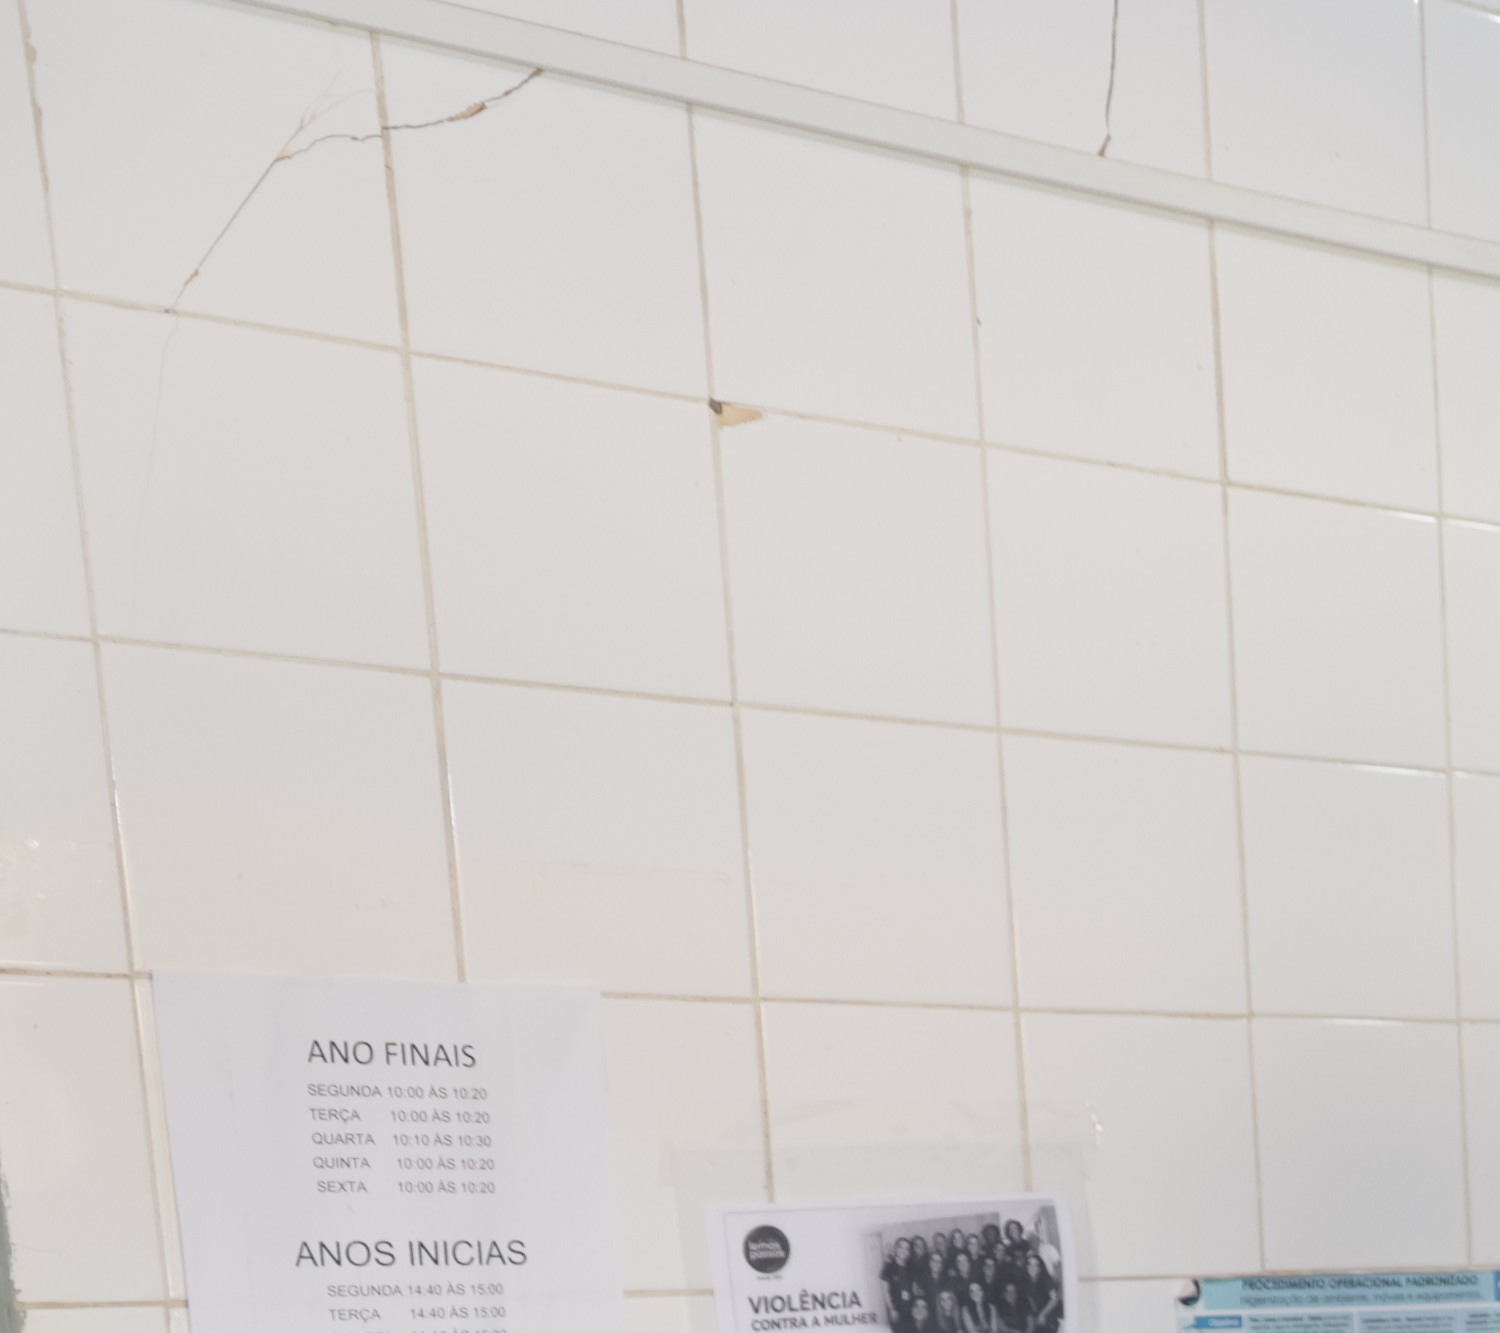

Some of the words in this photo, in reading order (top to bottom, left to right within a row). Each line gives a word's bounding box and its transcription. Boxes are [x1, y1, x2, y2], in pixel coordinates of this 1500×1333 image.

[307, 1040, 374, 1065] ANO
[385, 1042, 477, 1068] FINAIS
[307, 1084, 383, 1098] SEGUNDA
[387, 1086, 424, 1098] 10:00
[428, 1084, 448, 1099] ÀS
[453, 1087, 488, 1100] 10:20
[309, 1108, 362, 1124] TERÇA
[390, 1110, 428, 1122] 10:00
[431, 1108, 451, 1123] ÀS
[456, 1111, 490, 1124] 10:20
[311, 1132, 376, 1146] QUARTA
[393, 1134, 430, 1146] 10:10
[433, 1132, 453, 1146] ÀS
[458, 1135, 492, 1147] 10:30
[312, 1156, 371, 1169] QUINTA
[396, 1157, 433, 1170] 10:00
[437, 1155, 456, 1170] ÀS
[461, 1158, 495, 1170] 10:20
[316, 1180, 368, 1193] SEXTA
[398, 1181, 434, 1194] 10:00
[437, 1179, 457, 1194] ÀS
[461, 1182, 496, 1194] 10:20
[295, 1240, 396, 1267] ANOS
[408, 1239, 528, 1267] INICIAS
[327, 1284, 404, 1297] SEGUNDA
[408, 1283, 442, 1296] 14:40
[446, 1281, 466, 1296] ÀS
[471, 1283, 504, 1295] 15:00
[747, 1289, 863, 1314] VIOLÊNCIA
[329, 1308, 382, 1323] TERÇA
[410, 1307, 445, 1319] 14:40
[449, 1305, 469, 1319] ÀS
[474, 1306, 507, 1318] 15:00
[751, 1316, 809, 1332] CONTRA
[811, 1315, 823, 1327] A
[824, 1312, 878, 1327] MULHER
